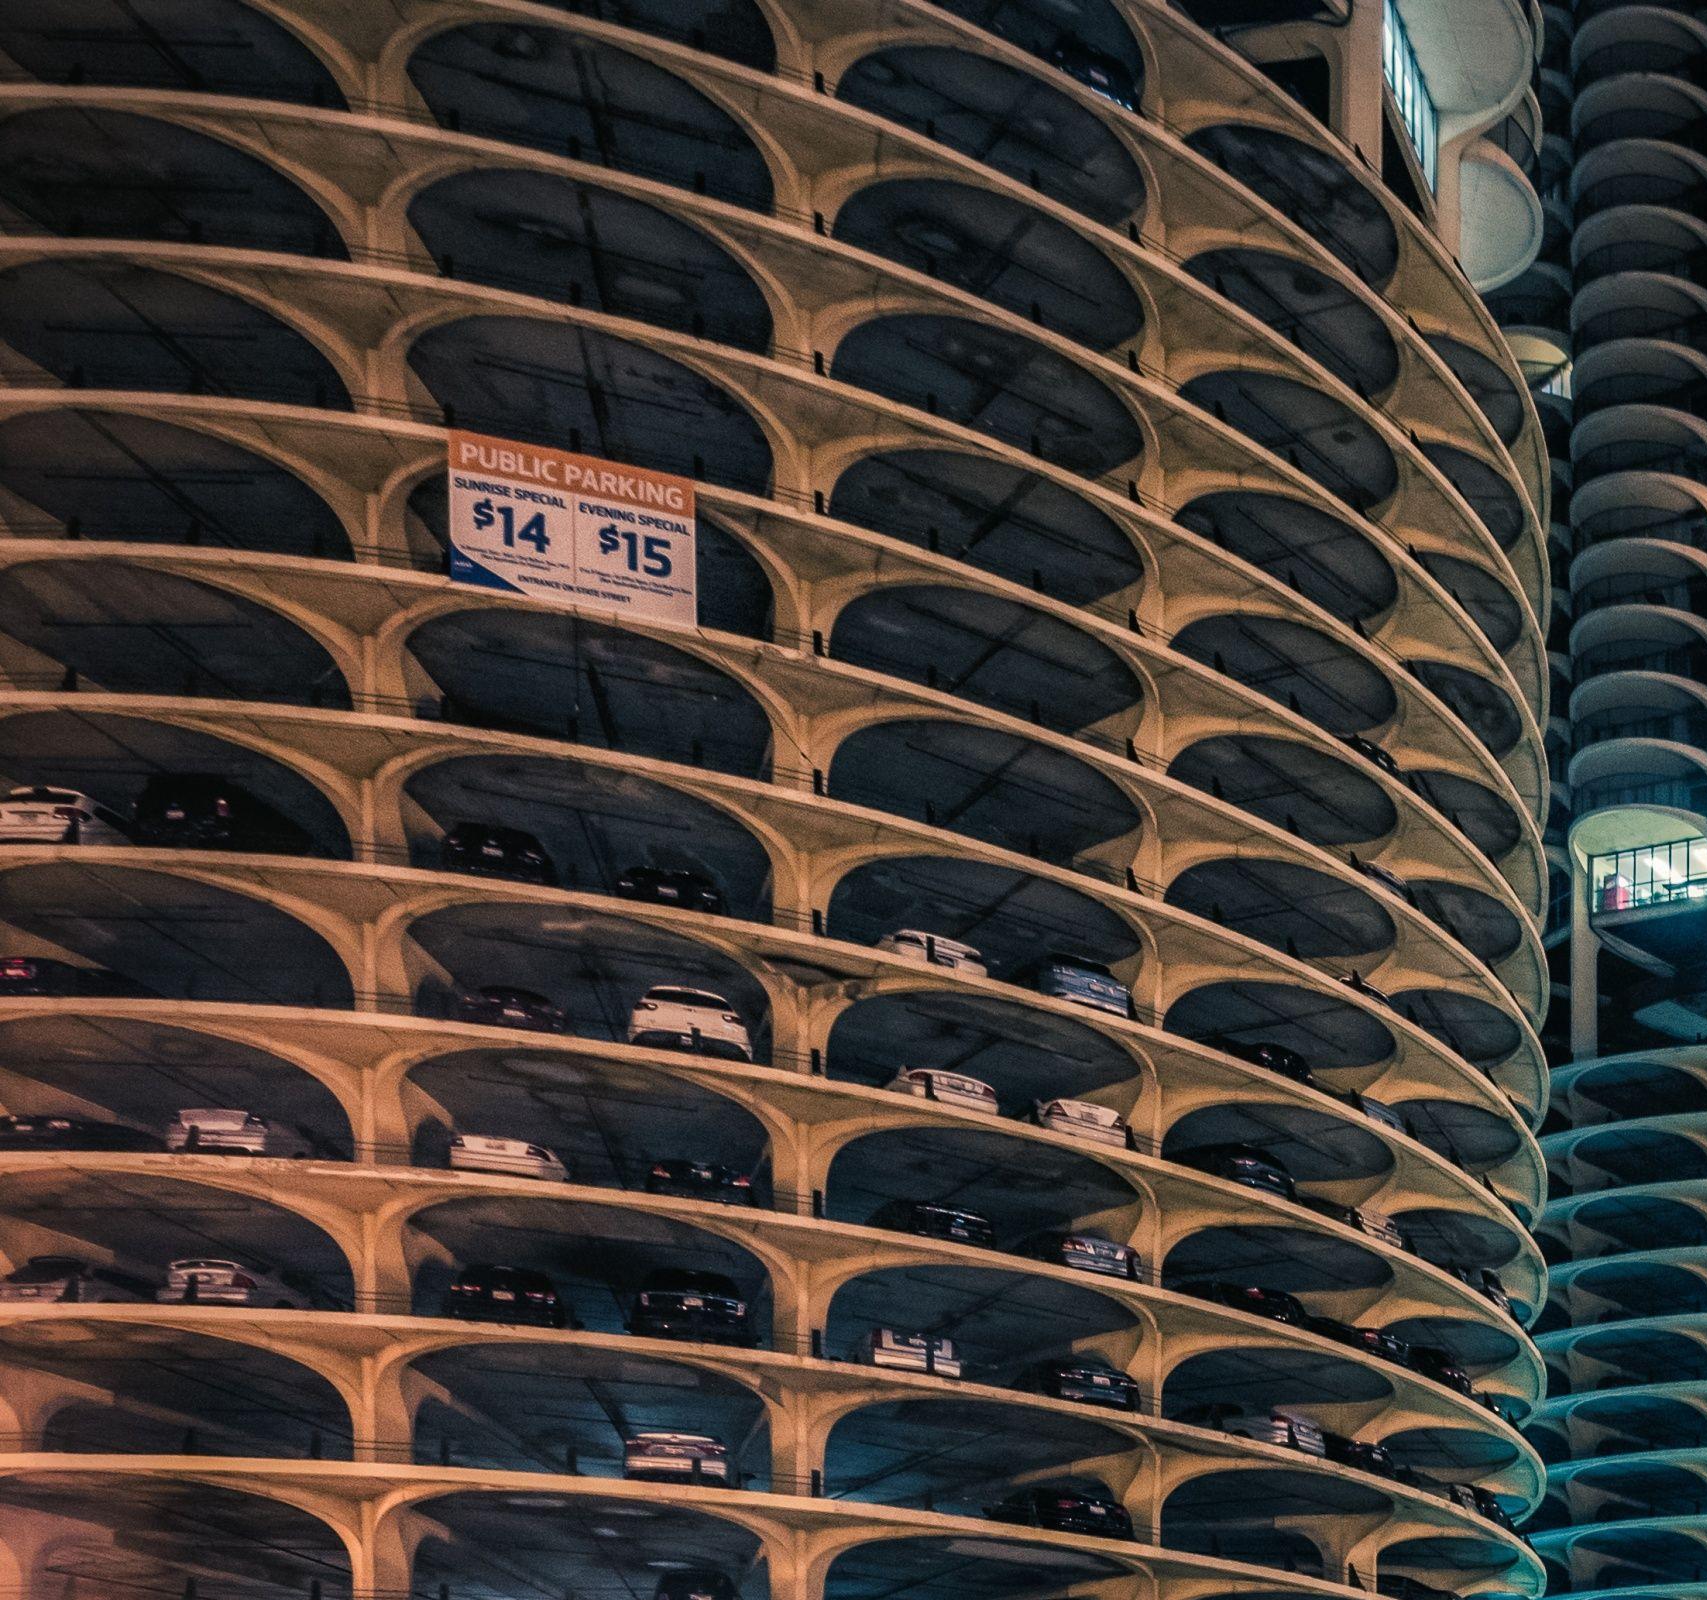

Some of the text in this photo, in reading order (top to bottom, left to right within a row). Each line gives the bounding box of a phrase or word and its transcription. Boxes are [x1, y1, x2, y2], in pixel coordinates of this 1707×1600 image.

[454, 477, 567, 509] SUNRISE SPECIAL
[460, 442, 684, 510] PUBLIC PARKING
[473, 498, 550, 554] $14
[579, 501, 691, 536] EVENING SPECIAL
[599, 524, 673, 578] $15
